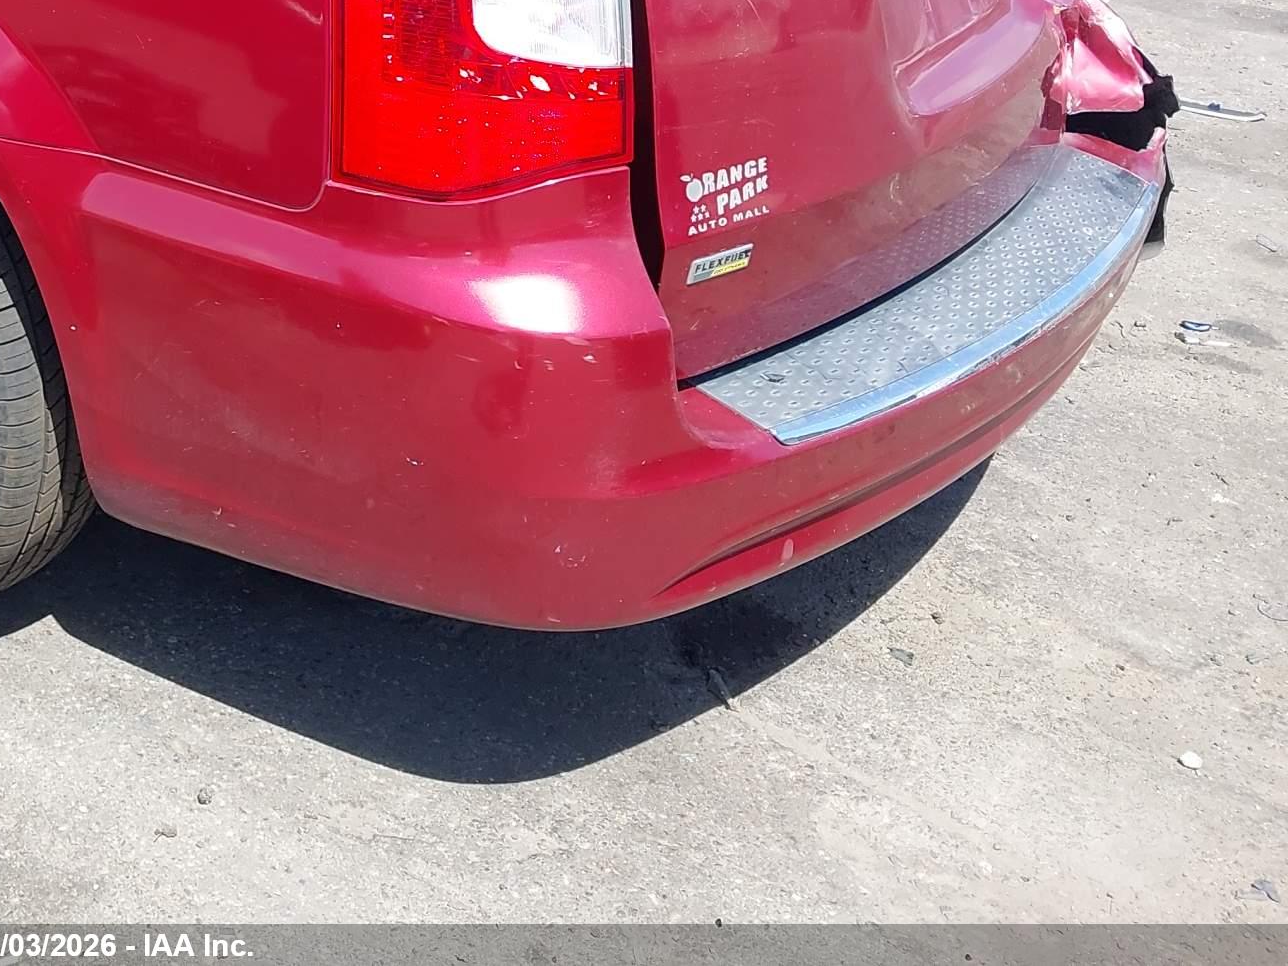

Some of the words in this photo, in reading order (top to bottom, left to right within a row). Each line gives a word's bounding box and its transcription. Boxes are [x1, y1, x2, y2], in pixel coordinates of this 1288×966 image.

[685, 156, 768, 202] ORANGE
[716, 174, 768, 215] PARK
[688, 217, 727, 236] AUTO
[733, 205, 770, 222] MALL
